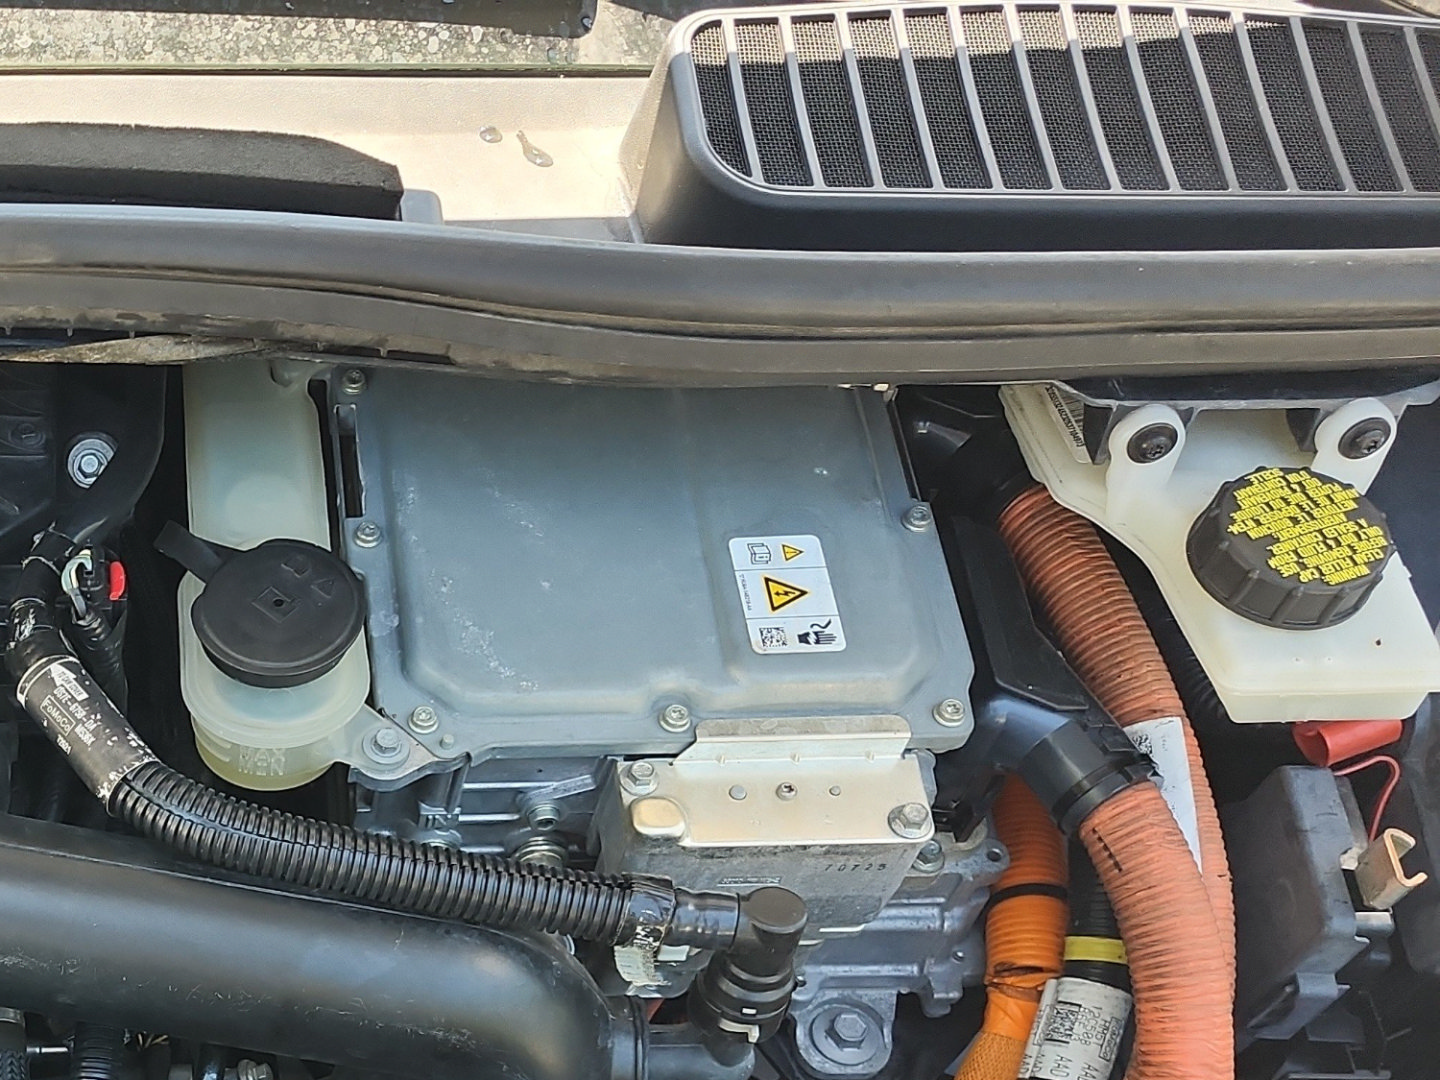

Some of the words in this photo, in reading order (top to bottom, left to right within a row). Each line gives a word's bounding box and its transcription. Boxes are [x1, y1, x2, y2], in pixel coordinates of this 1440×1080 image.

[1285, 470, 1311, 483] D'UN
[1300, 477, 1322, 489] DOT
[1233, 477, 1287, 500] CONTENANT
[1290, 484, 1301, 492] 4
[1305, 482, 1343, 498] PLOYER
[1330, 488, 1359, 503] AVANT
[1237, 486, 1292, 509] PROVENANT
[1269, 498, 1286, 510] DU
[1283, 491, 1307, 505] QUE
[1299, 500, 1316, 511] LE
[1313, 495, 1331, 507] DE
[1230, 503, 1270, 522] LIQUIDE
[1308, 496, 1358, 519] NETTOYER
[1269, 510, 1347, 541] AVERTISSEMENT:
[1293, 512, 1311, 524] LE
[1356, 518, 1368, 527] A
[1244, 518, 1293, 539] BOUCHON
[1322, 521, 1359, 538] SEALED
[1356, 526, 1383, 540] ONLY
[1266, 532, 1323, 555] CONTAINER.
[1326, 537, 1336, 547] 4
[1337, 531, 1358, 546] DOT
[1350, 536, 1388, 553] BEFORE
[1297, 542, 1327, 557] FLUID
[1299, 545, 1353, 568] REMOVING.
[1352, 548, 1384, 564] CLEAN
[1267, 551, 1298, 568] FROM
[1318, 556, 1354, 574] FILLER
[1277, 562, 1301, 577] USE
[1295, 568, 1320, 582] CAP
[1321, 564, 1370, 585] WARNING:
[43, 700, 71, 733] FoMoCo
[1050, 1055, 1073, 1079] AAD
